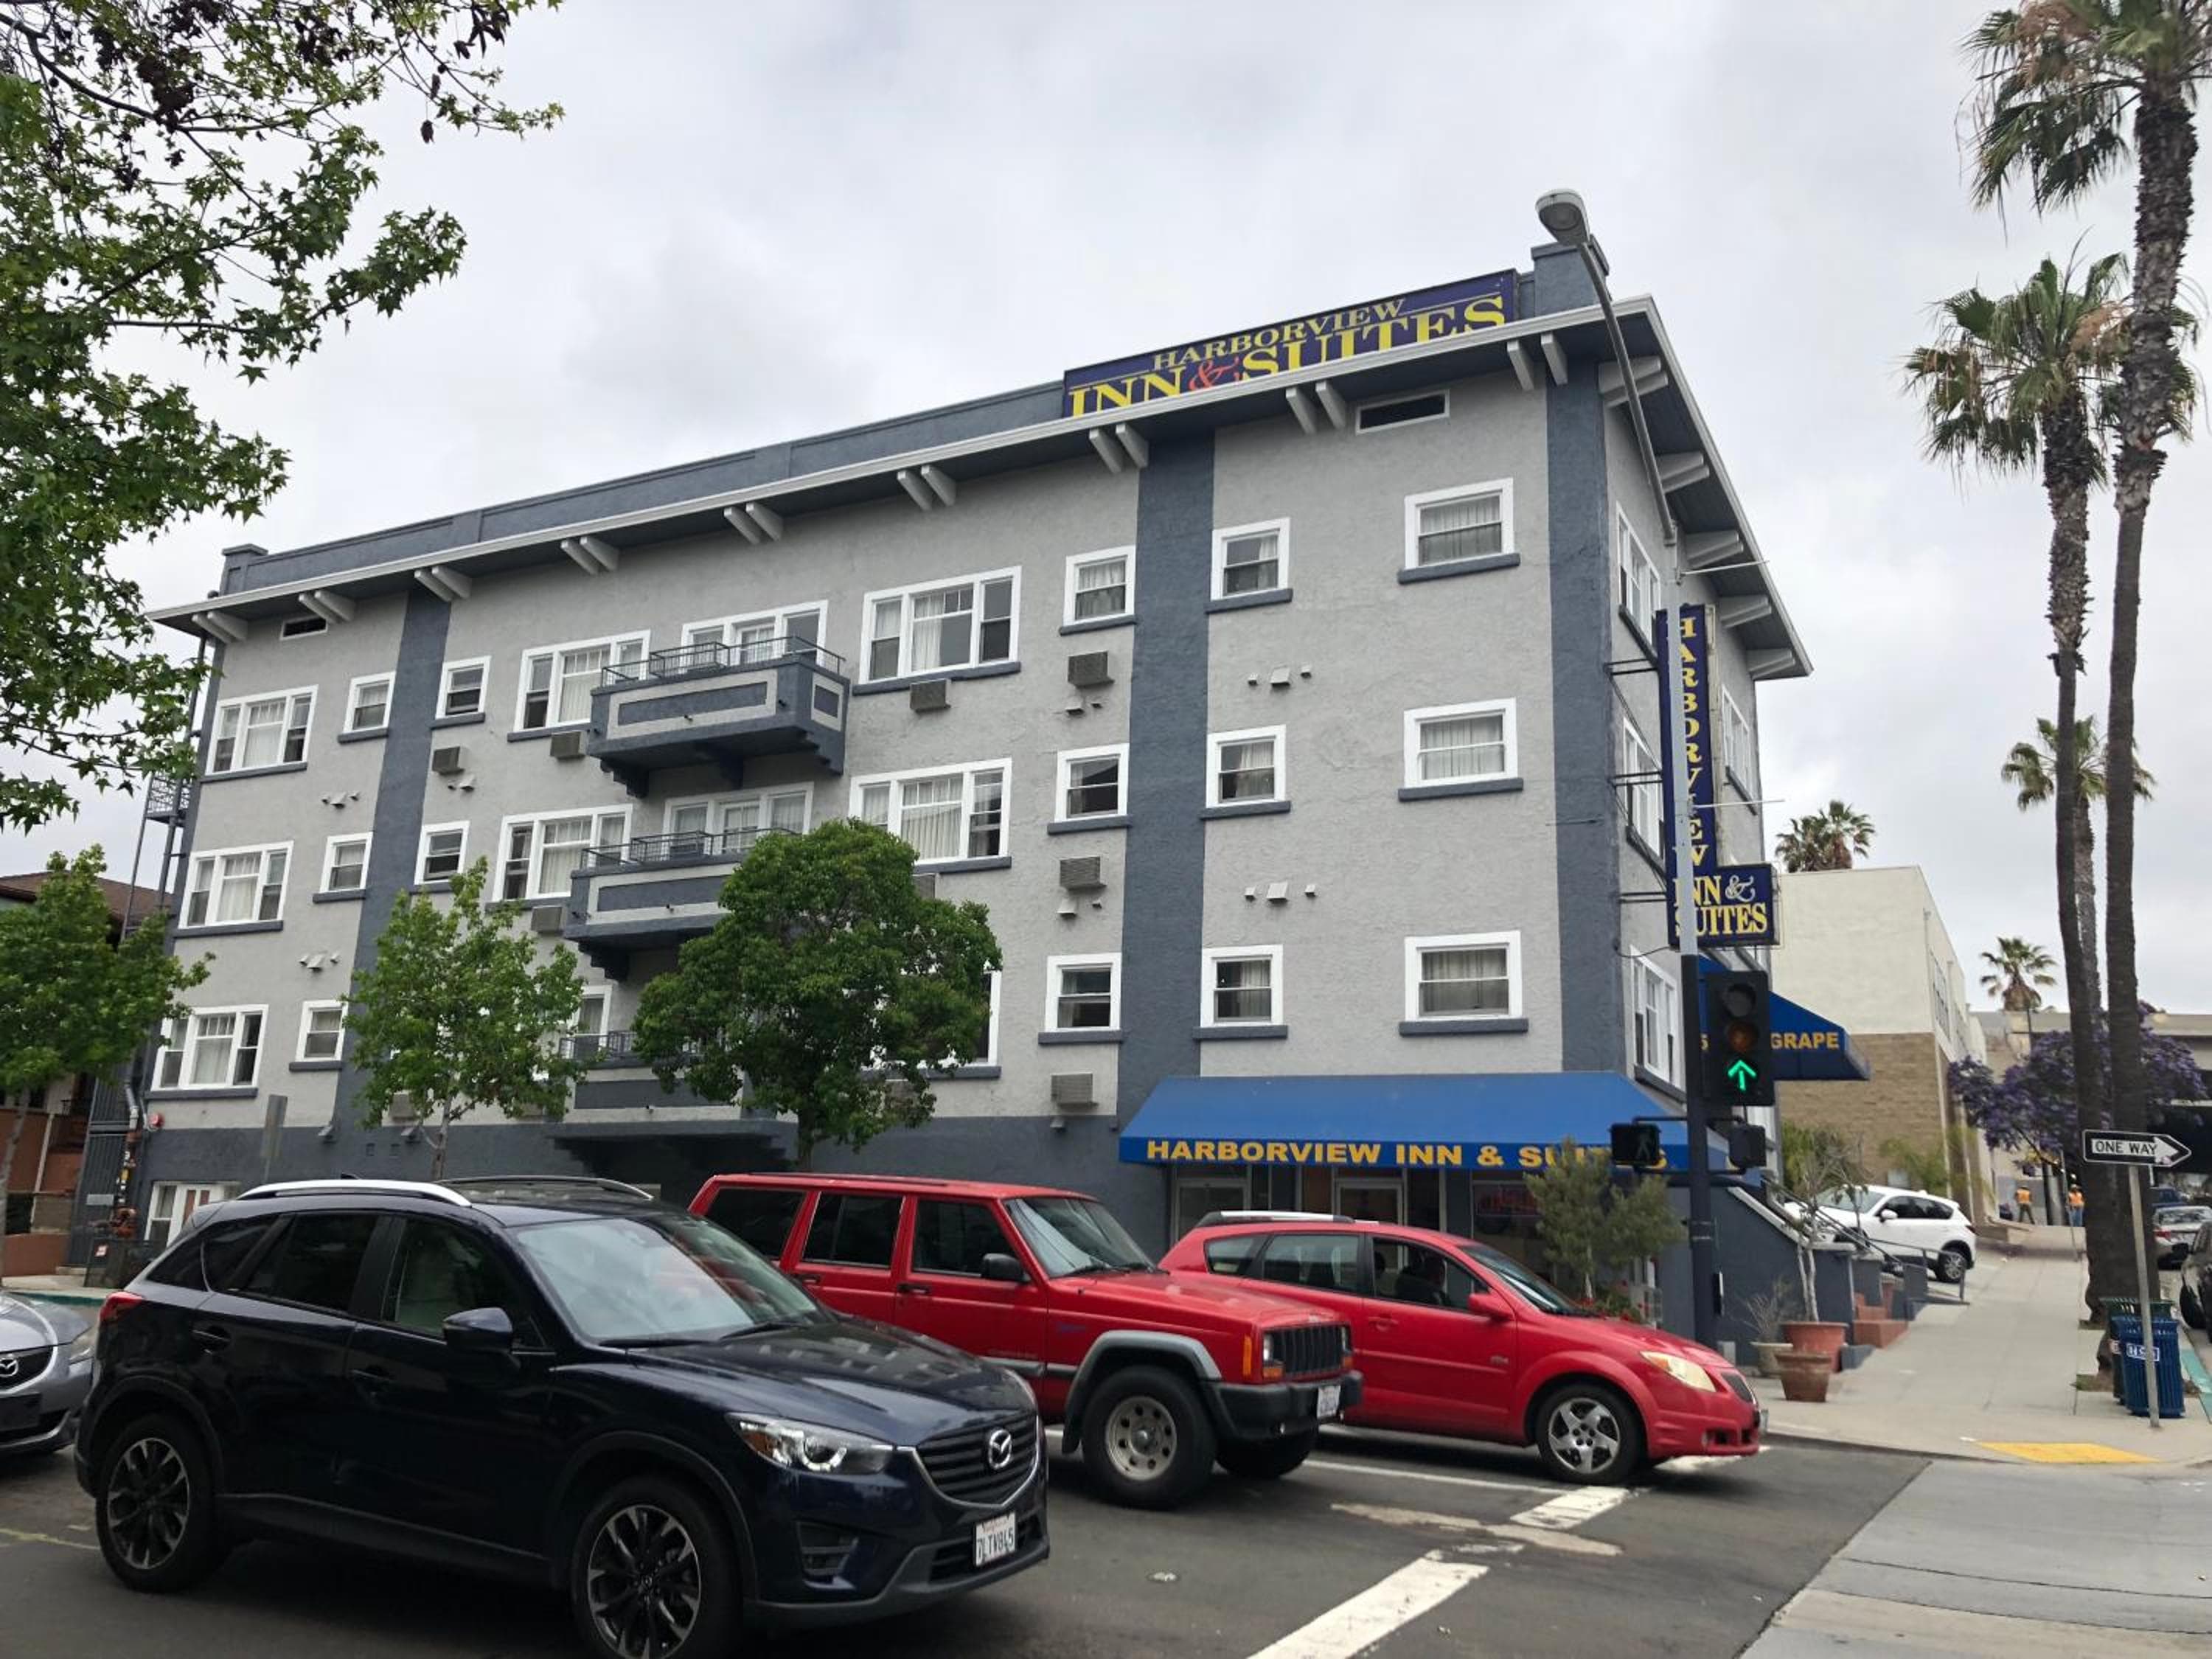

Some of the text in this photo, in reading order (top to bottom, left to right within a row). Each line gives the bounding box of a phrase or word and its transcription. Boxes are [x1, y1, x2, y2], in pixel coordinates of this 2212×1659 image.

[1154, 298, 1405, 370] HARBORVIEW
[1068, 296, 1506, 419] INN & SUITES
[1666, 616, 1709, 866] HARBORVEW
[1725, 874, 1756, 902] &
[1770, 1032, 1840, 1050] GRAPE
[1147, 1140, 1381, 1164] HARBORVIEW
[1396, 1144, 1463, 1166] INN
[1477, 1145, 1504, 1166] &
[2095, 1141, 2157, 1155] ONE WAY
